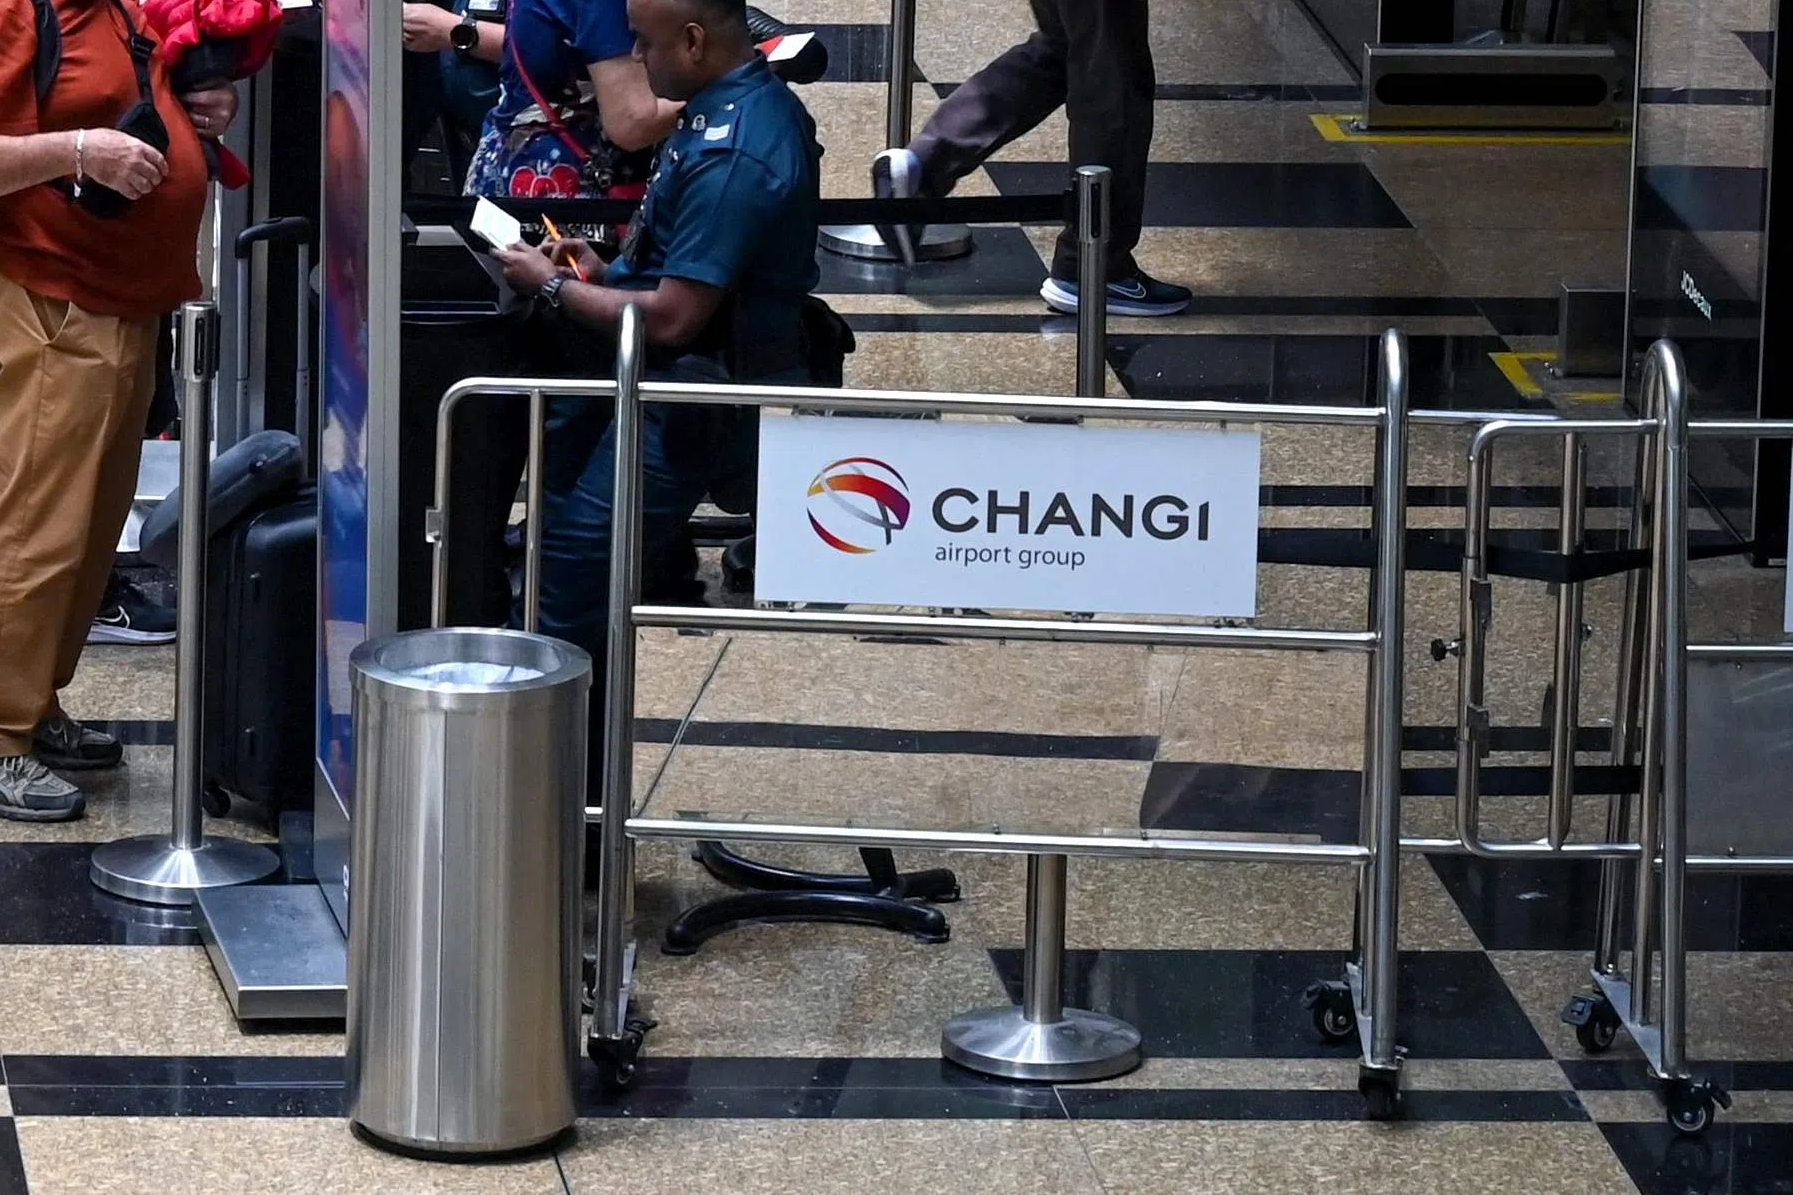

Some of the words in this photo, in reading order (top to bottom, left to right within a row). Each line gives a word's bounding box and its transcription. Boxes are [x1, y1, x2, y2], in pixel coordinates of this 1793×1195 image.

[932, 487, 1210, 542] CHANGI
[934, 543, 1011, 566] airport
[1018, 546, 1086, 571] group
